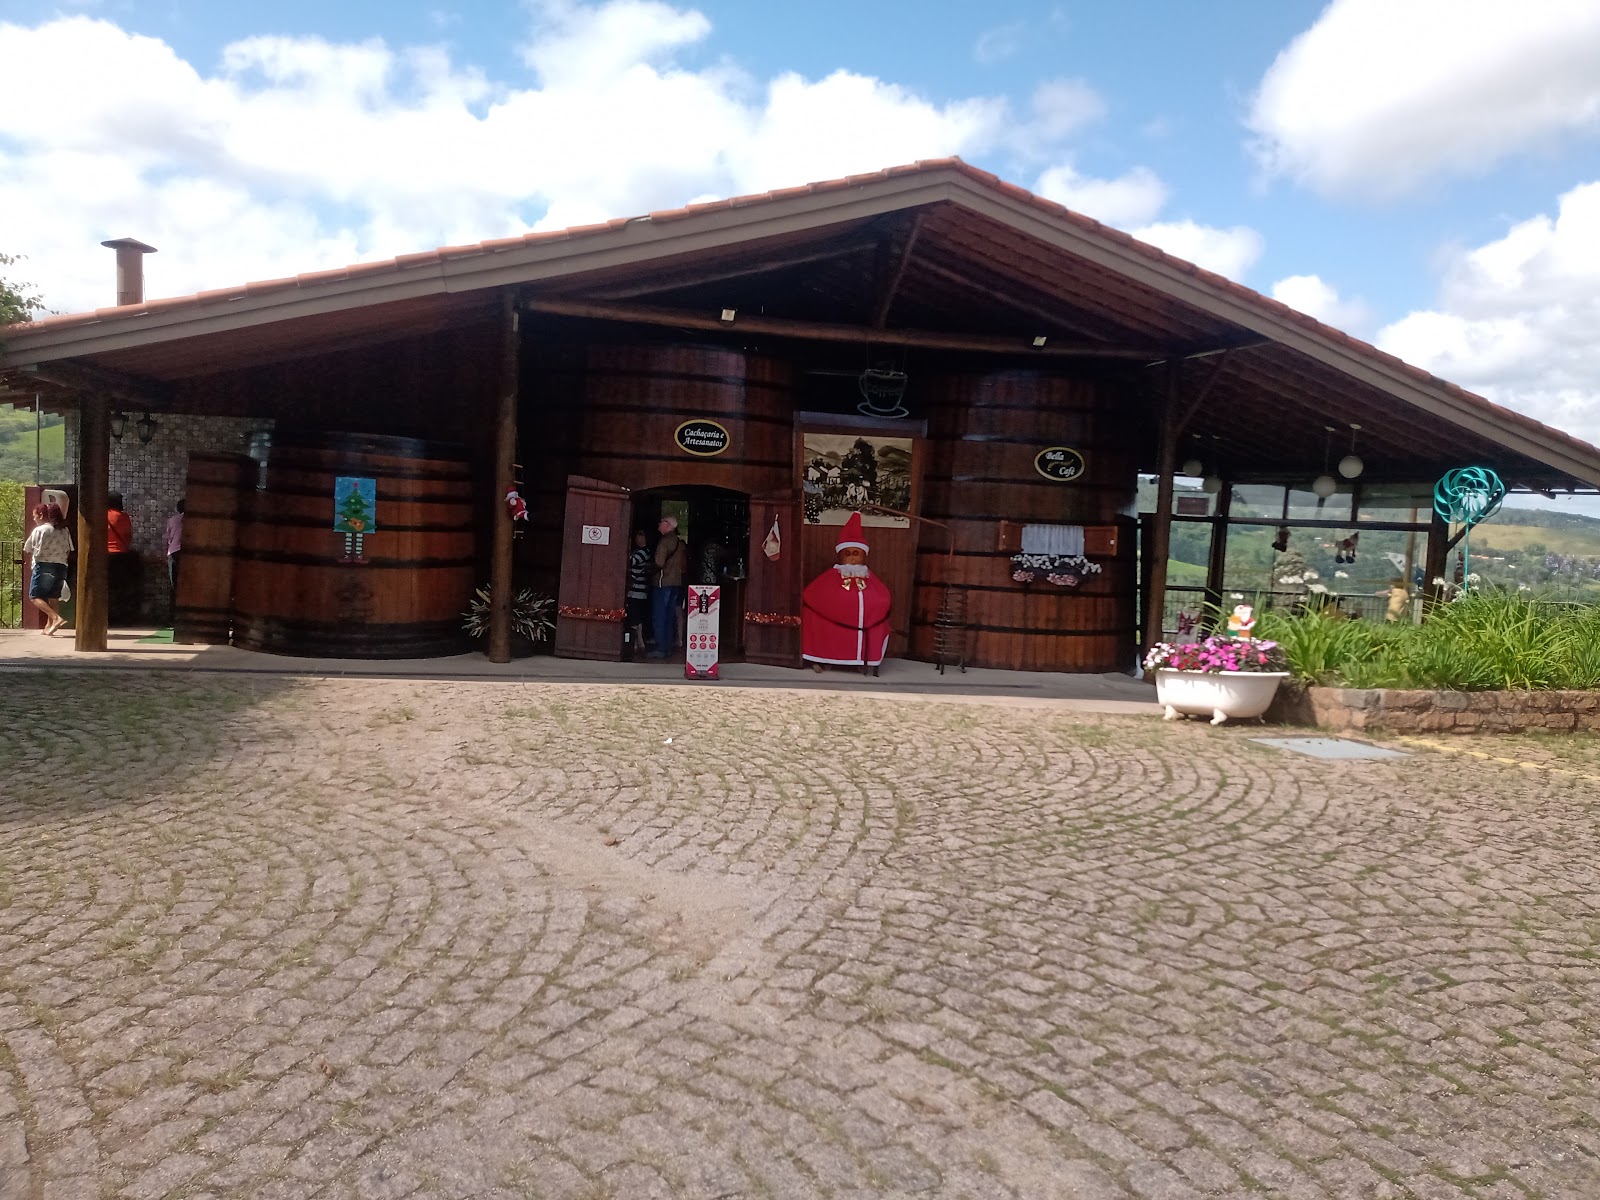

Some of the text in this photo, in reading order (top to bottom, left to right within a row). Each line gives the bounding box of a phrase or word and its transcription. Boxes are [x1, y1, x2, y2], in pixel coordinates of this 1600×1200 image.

[684, 428, 719, 439] Cachaçaria
[683, 437, 723, 447] Artesanatos
[1045, 451, 1064, 460] Bella
